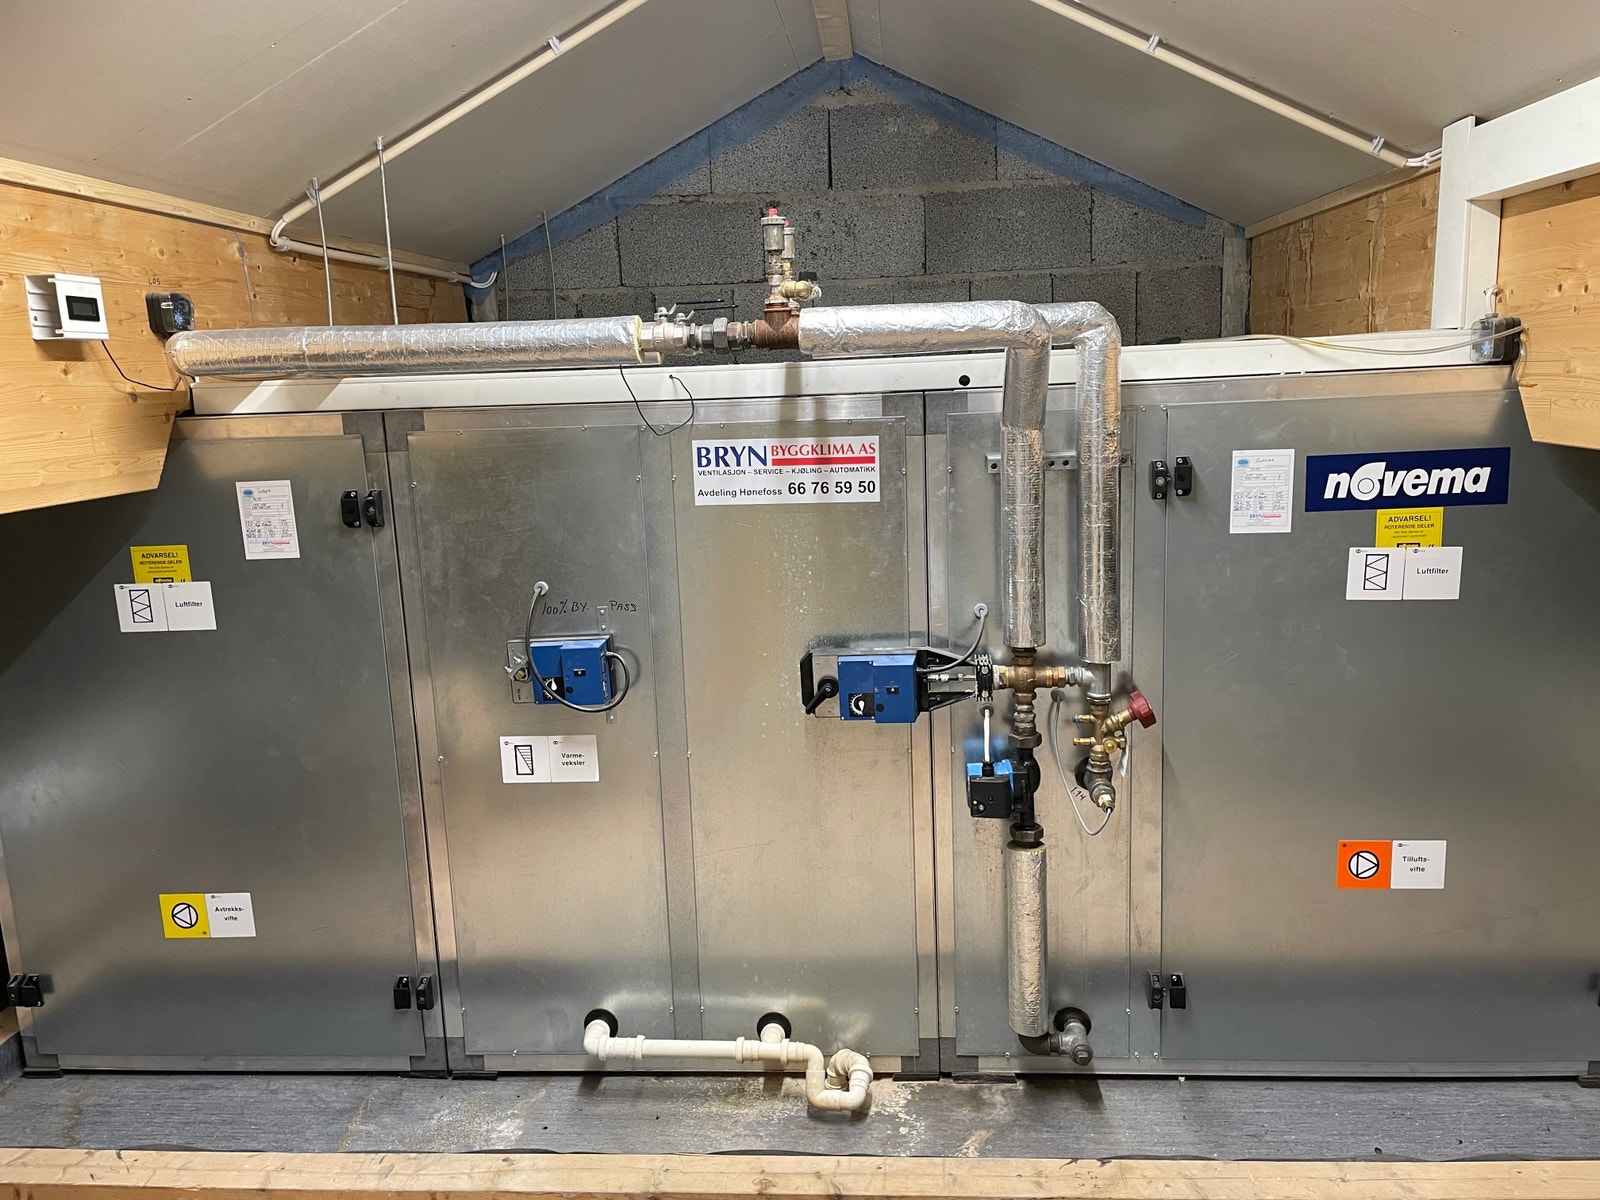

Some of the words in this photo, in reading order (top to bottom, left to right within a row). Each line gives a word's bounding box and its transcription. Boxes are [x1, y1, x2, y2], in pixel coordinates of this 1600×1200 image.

[696, 445, 768, 468] BRYN
[771, 443, 855, 457] BYGGKLIMA
[858, 442, 876, 455] AS
[697, 469, 746, 477] VENTILASJON
[753, 468, 784, 476] SERVICE
[791, 467, 823, 475] KJØLING
[829, 466, 876, 474] AUTOMATIKK
[697, 488, 737, 498] Avdeling
[739, 487, 783, 497] Hønefoss
[788, 482, 806, 495] 66
[811, 481, 830, 494] 76
[834, 480, 852, 494] 59
[858, 480, 876, 493] 50
[1323, 461, 1492, 501] novema
[1388, 514, 1432, 523] ADVARSEL!
[1416, 567, 1449, 575] Luftfilter
[541, 598, 568, 616] 100%
[609, 600, 637, 613] PASS
